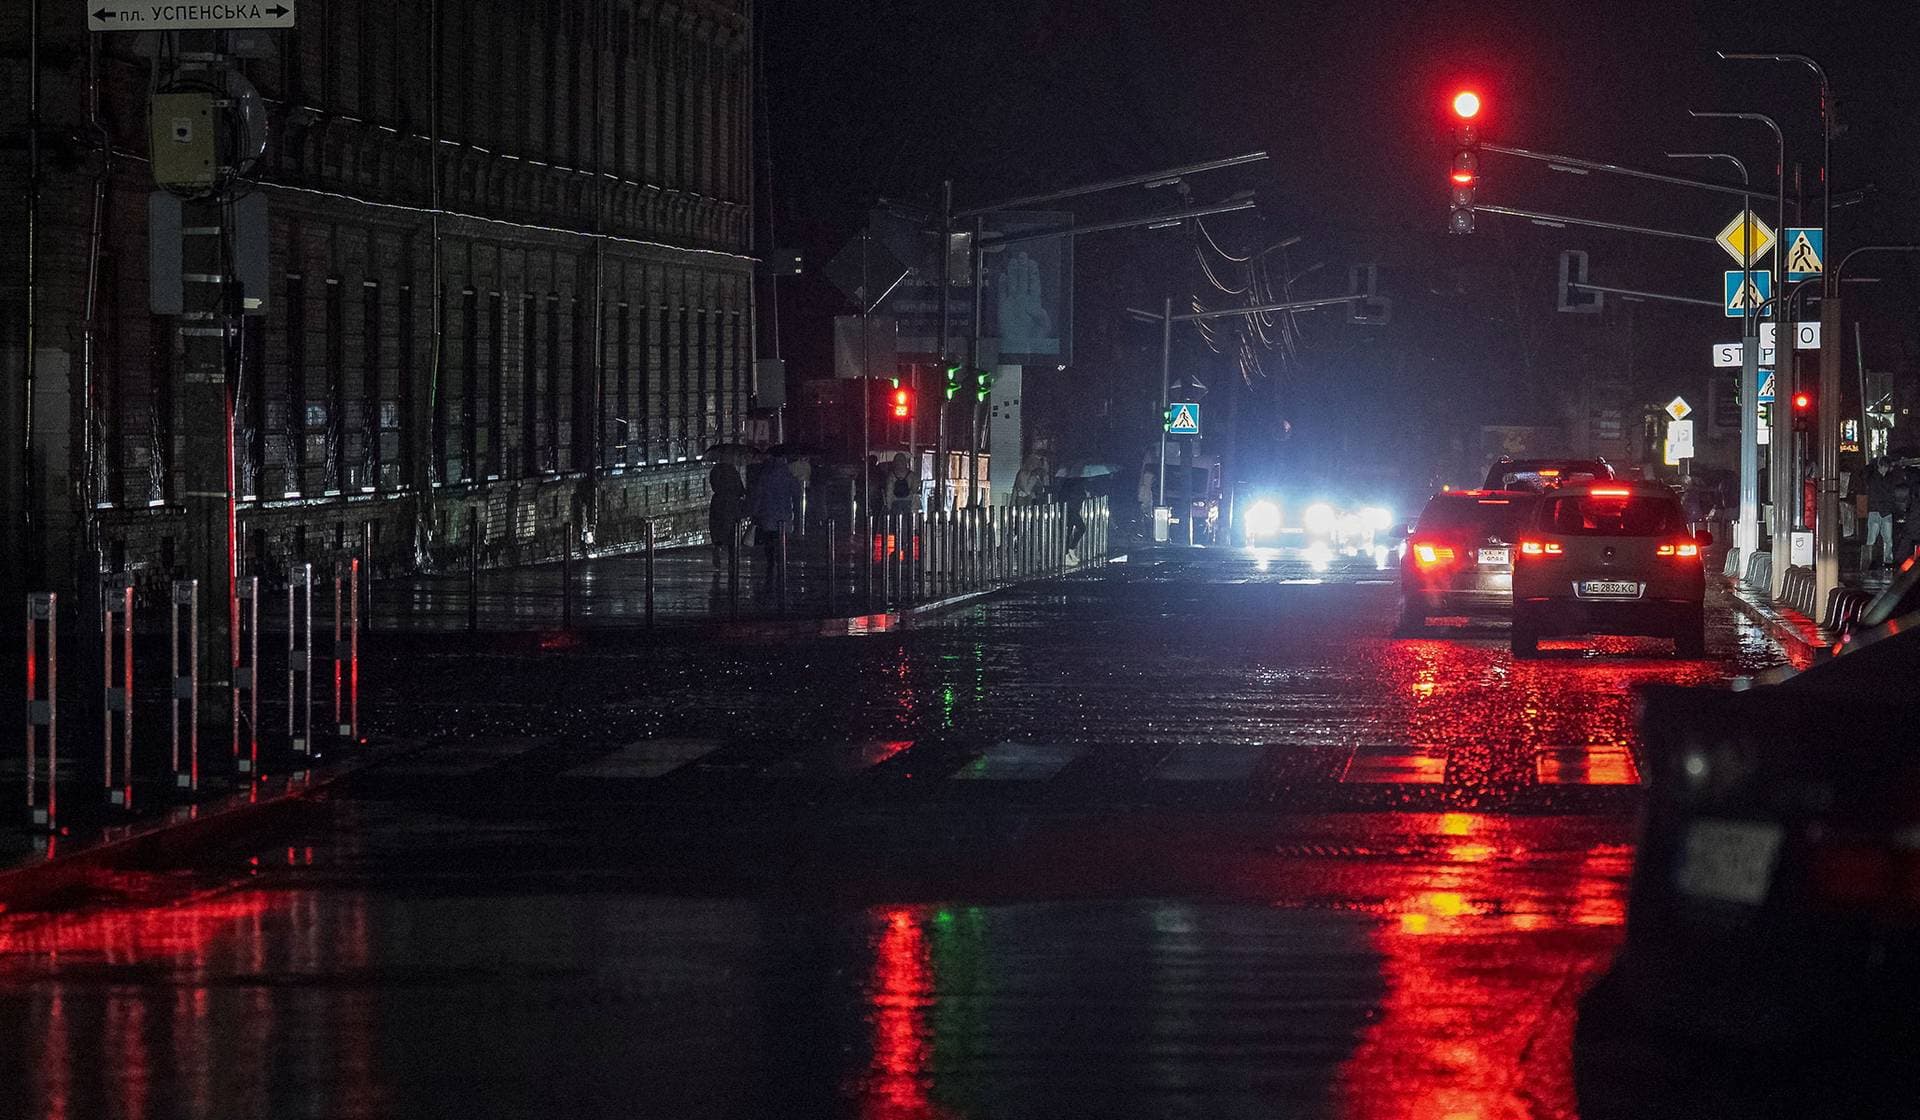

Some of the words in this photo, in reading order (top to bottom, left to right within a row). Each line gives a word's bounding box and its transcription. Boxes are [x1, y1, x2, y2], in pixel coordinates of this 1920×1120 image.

[120, 11, 145, 22] пл.
[151, 4, 261, 21] УСПЕНСЬКА
[1722, 347, 1773, 362] STP
[1587, 583, 1598, 592] AE
[1600, 583, 1620, 593] 2832
